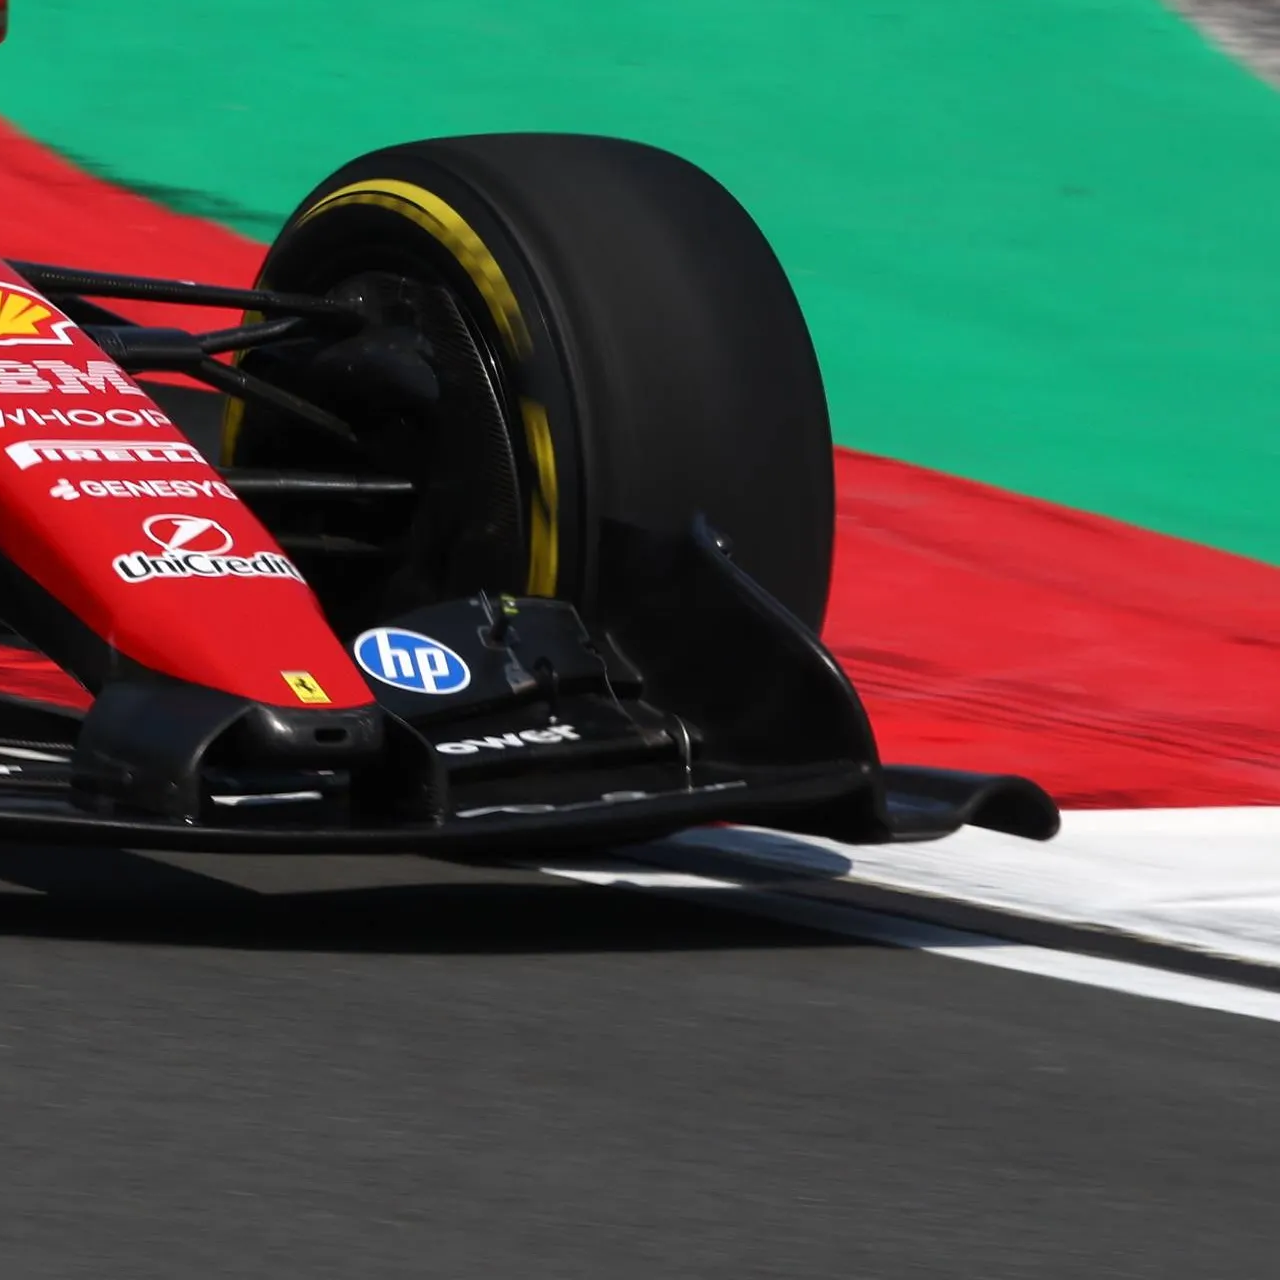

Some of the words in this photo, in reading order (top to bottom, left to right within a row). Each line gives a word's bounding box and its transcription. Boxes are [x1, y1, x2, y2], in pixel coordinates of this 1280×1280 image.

[6, 440, 208, 470] PIRELLI
[375, 629, 451, 693] hp
[435, 724, 581, 754] ower
